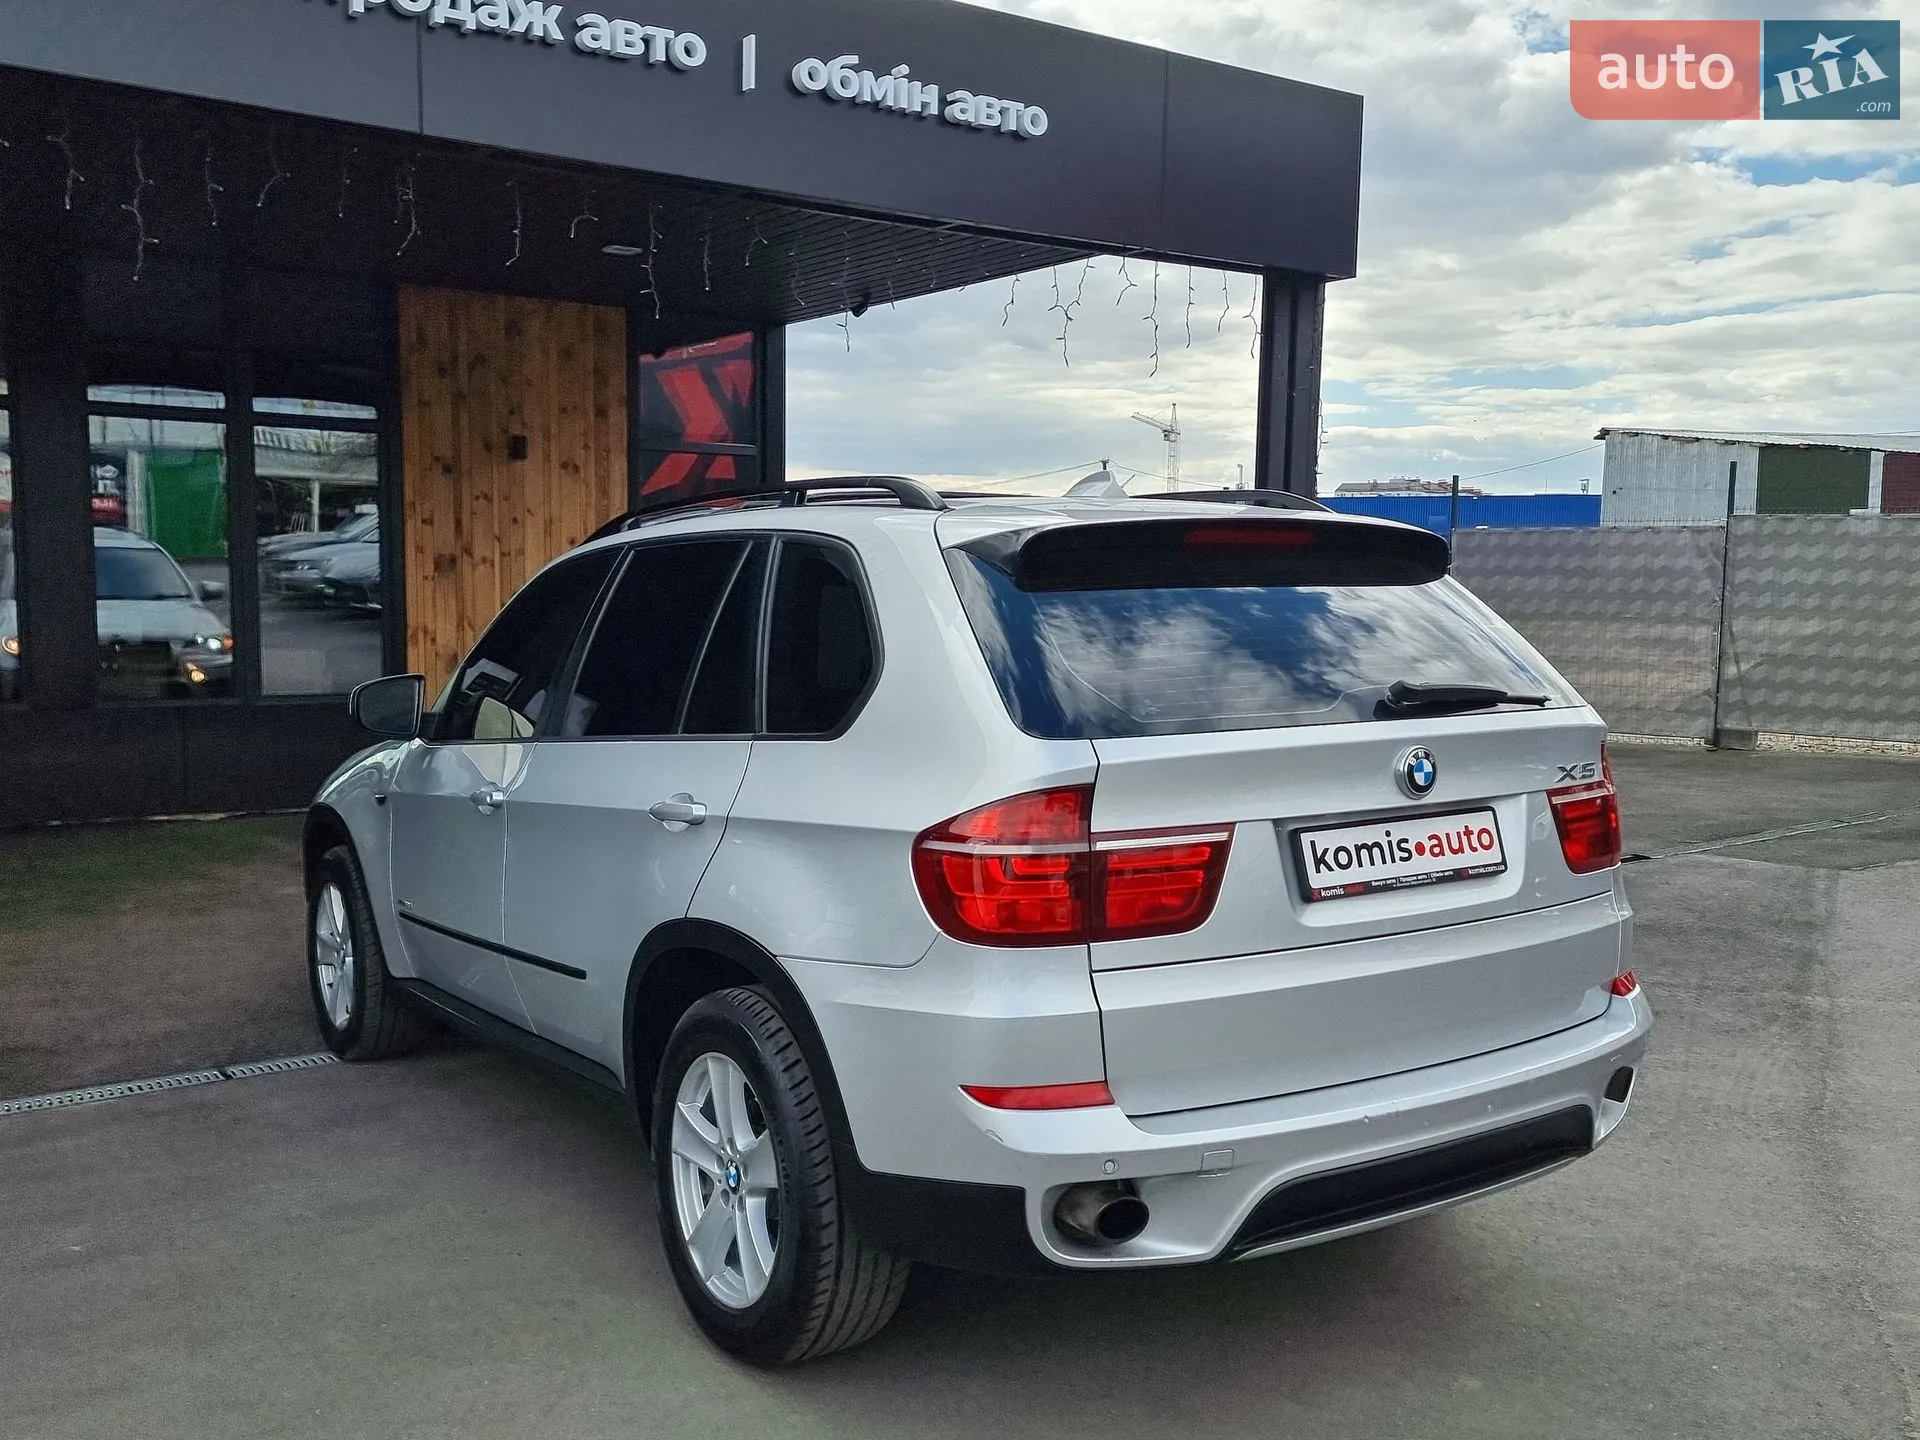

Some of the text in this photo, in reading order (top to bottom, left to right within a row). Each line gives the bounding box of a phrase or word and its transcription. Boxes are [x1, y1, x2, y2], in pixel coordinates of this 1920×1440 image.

[574, 13, 708, 70] авто
[791, 54, 940, 117] обмін
[944, 88, 1049, 138] авто
[1554, 762, 1596, 783] X5
[1320, 886, 1345, 898] komis
